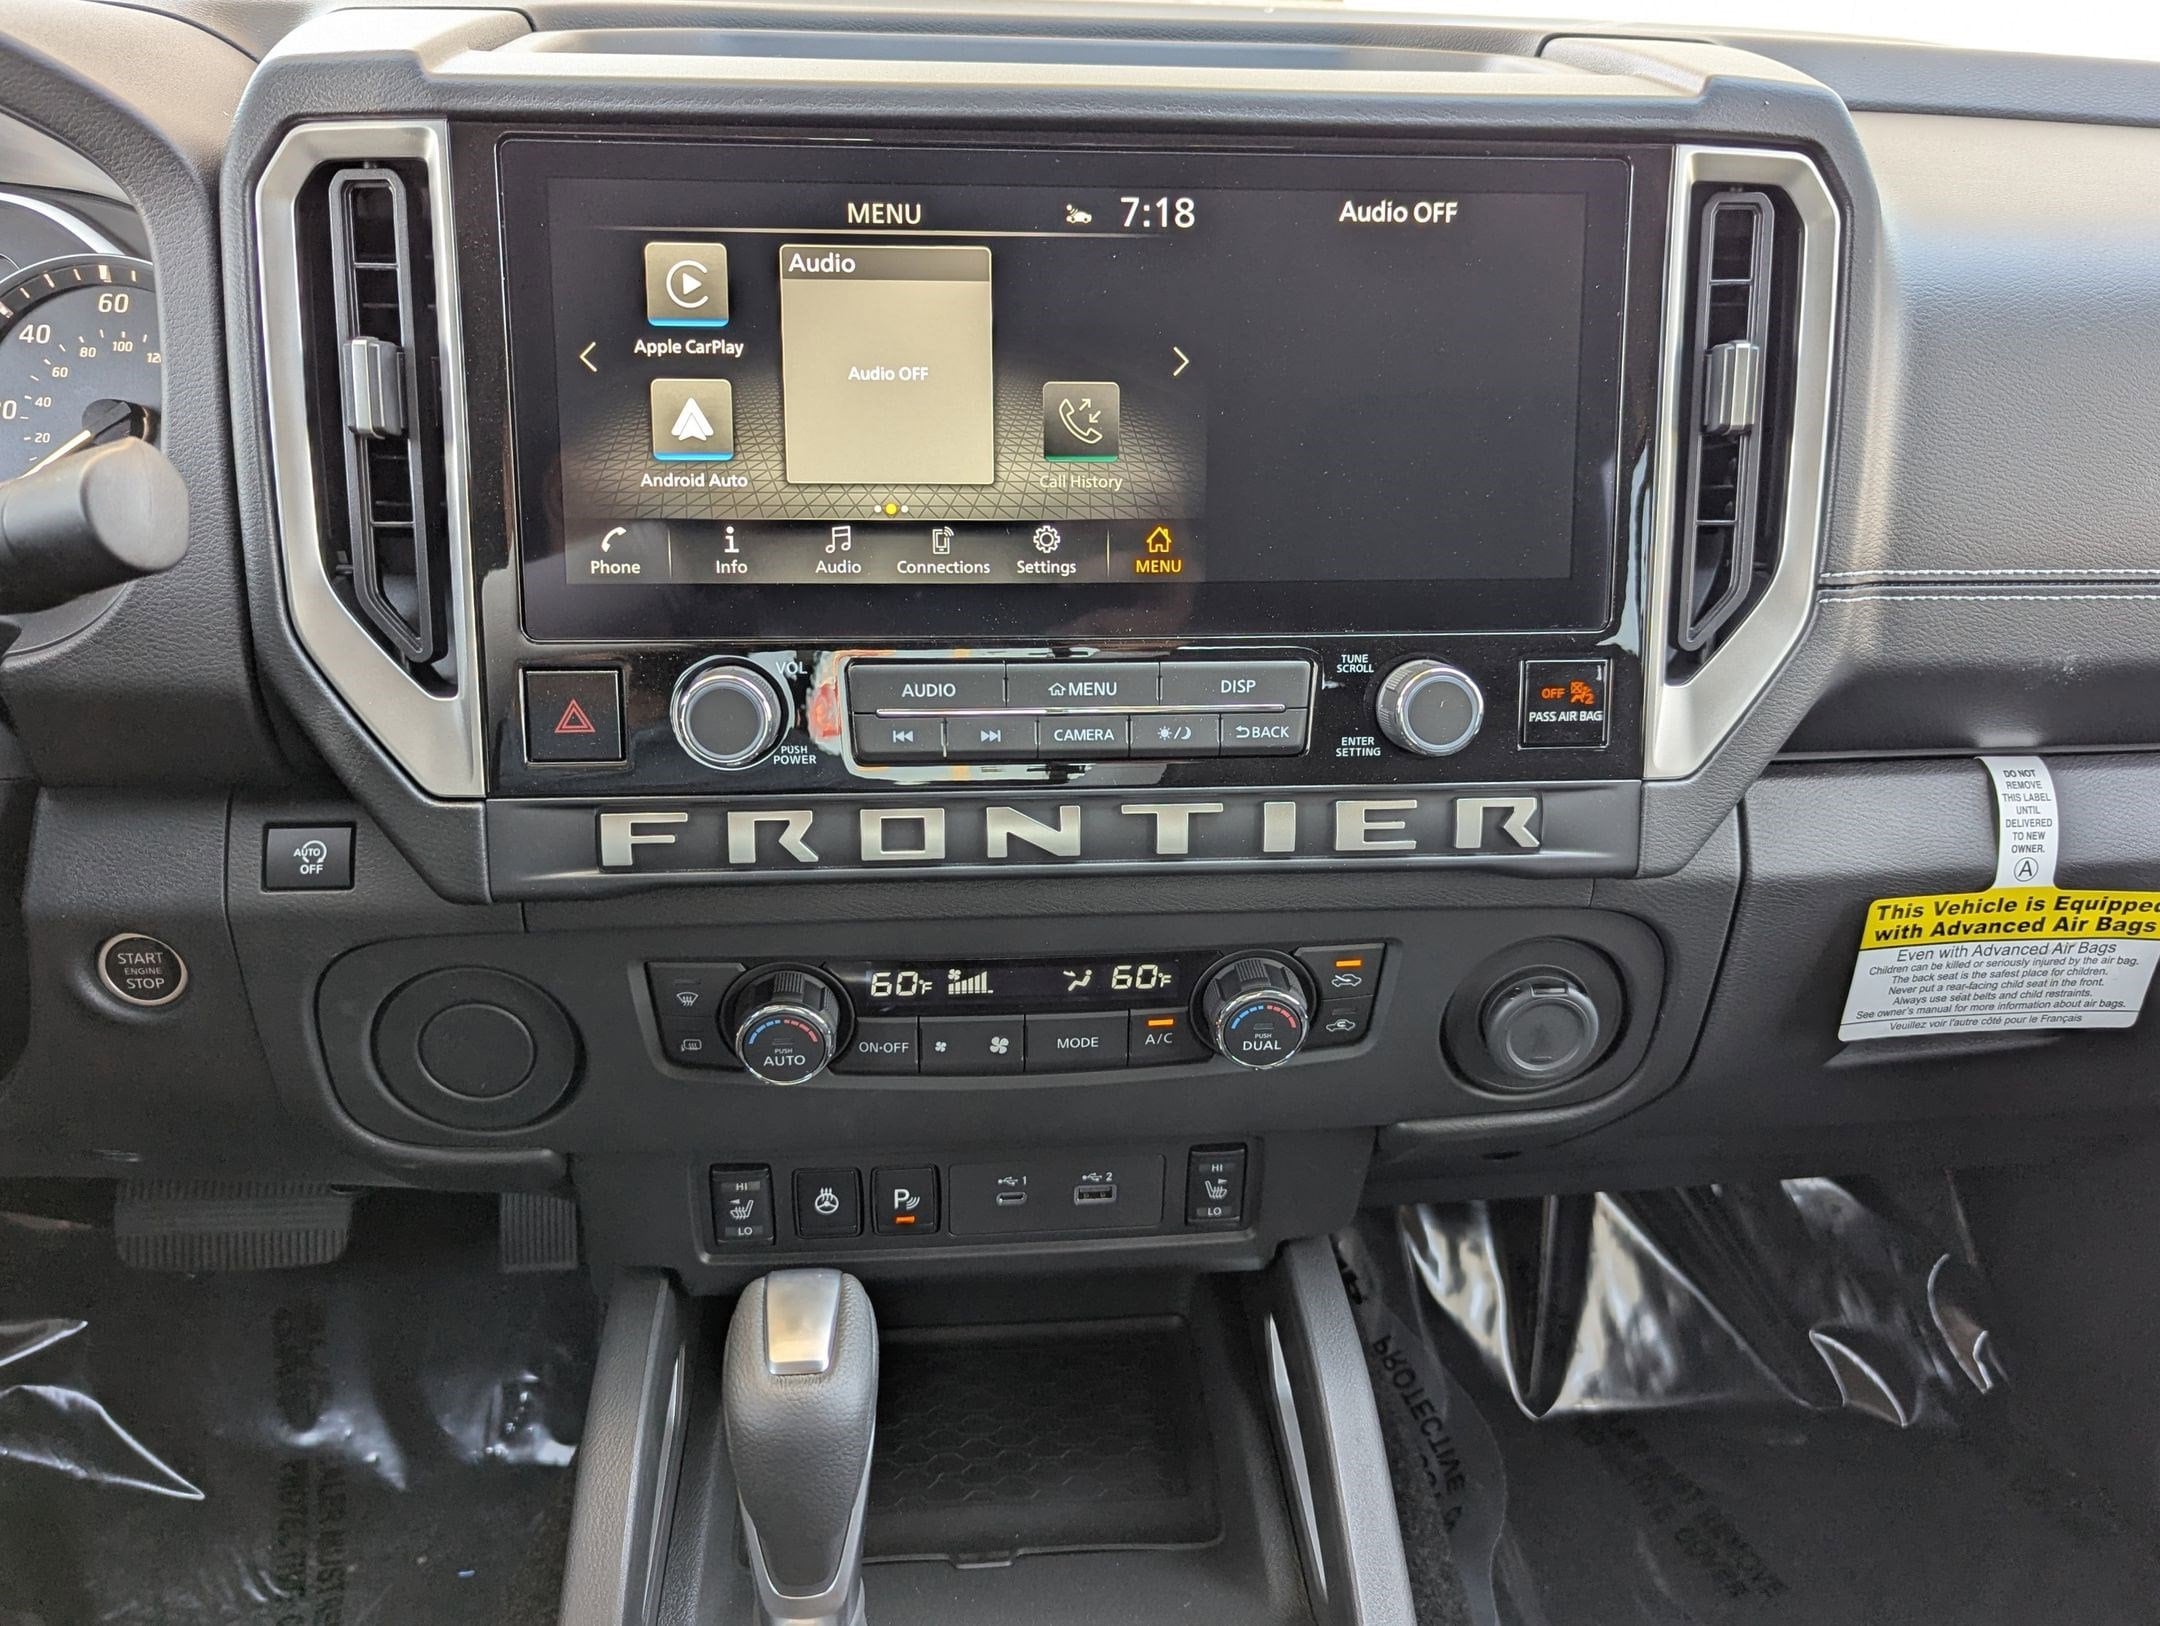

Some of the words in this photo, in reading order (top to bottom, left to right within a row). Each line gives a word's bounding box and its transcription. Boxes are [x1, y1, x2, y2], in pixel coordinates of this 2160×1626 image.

[847, 203, 922, 225] MENU
[1120, 197, 1196, 228] 7:18
[1339, 200, 1408, 223] Audio
[1414, 201, 1458, 224] OFF
[788, 253, 856, 273] Audio
[98, 293, 129, 313] 60
[19, 325, 51, 344] 40
[79, 347, 97, 358] 80
[112, 341, 133, 352] 100
[633, 339, 683, 357] Apple
[685, 339, 745, 358] CarPlay
[146, 353, 161, 363] 12
[51, 367, 69, 378] 60
[848, 366, 895, 381] Audio
[899, 367, 929, 381] OFF
[34, 397, 52, 408] 40
[0, 400, 17, 420] 0
[34, 433, 51, 443] 20
[640, 473, 705, 488] Android
[708, 474, 748, 488] Auto
[1039, 475, 1066, 489] Call
[1070, 475, 1123, 491] History
[590, 560, 641, 575] Phone
[715, 560, 748, 575] Info
[815, 560, 862, 574] Audio
[897, 560, 991, 574] Connections
[1016, 560, 1077, 577] Settings
[1135, 559, 1183, 574] MENU
[1341, 654, 1369, 664] TUNE
[775, 661, 808, 675] VOL
[1336, 664, 1375, 674] SCROLL
[901, 683, 957, 698] AUDIO
[1068, 682, 1118, 697] MENU
[1220, 679, 1257, 694] DISP
[1541, 687, 1565, 699] OFF
[1528, 711, 1556, 723] PASS
[1557, 710, 1578, 722] AIR
[1579, 710, 1604, 722] BAG
[1053, 728, 1115, 742] CAMERA
[1251, 726, 1290, 739] BACK
[1341, 736, 1375, 747] ENTER
[780, 745, 808, 755] PUSH
[1335, 746, 1381, 757] SETTING
[773, 754, 817, 765] POWER
[2003, 770, 2017, 778] DO
[2018, 769, 2036, 778] NOT
[2006, 780, 2043, 790] REMOVE
[2002, 792, 2022, 802] THIS
[2023, 793, 2051, 802] LABEL
[2016, 805, 2041, 815] UNTIL
[2005, 818, 2053, 828] DELIVERED
[600, 797, 1541, 866] FRONTIER
[2013, 832, 2024, 841] TO
[2026, 832, 2046, 841] NEW
[293, 847, 321, 858] AUTO
[2011, 844, 2045, 853] OWNER.
[300, 864, 323, 875] OFF
[2018, 860, 2033, 877] A
[1877, 903, 1924, 920] This
[1933, 897, 2017, 916] Vehicle
[2025, 896, 2045, 912] is
[1875, 924, 1923, 941] with
[1929, 917, 2046, 937] Advanced
[2052, 917, 2089, 932] Air
[2095, 917, 2157, 935] Bags
[117, 952, 163, 964] START
[1897, 950, 1934, 962] Even
[1939, 946, 1968, 958] with
[1971, 943, 2049, 957] Advanced
[2052, 942, 2075, 954] Air
[2078, 942, 2117, 956] Bags
[124, 967, 163, 975] ENGINE
[1869, 964, 1909, 976] Children
[1910, 965, 1928, 973] can
[1930, 961, 1943, 970] be
[1945, 960, 1971, 969] killed
[1973, 960, 1983, 968] or
[1986, 956, 2030, 968] seriously
[2032, 957, 2066, 967] injured
[2068, 957, 2081, 967] by
[2083, 956, 2098, 964] the
[2100, 956, 2116, 964] air
[2116, 956, 2139, 967] bag.
[1892, 975, 1910, 984] The
[1911, 973, 1934, 982] back
[1937, 972, 1958, 980] seat
[1960, 970, 1969, 979] is
[1971, 969, 1987, 978] the
[1989, 968, 2020, 979] safest
[2021, 967, 2049, 978] place
[2051, 967, 2066, 976] for
[2066, 966, 2109, 976] children.
[126, 978, 165, 989] STOP
[1888, 986, 1918, 995] Never
[1919, 984, 1935, 994] put
[1946, 980, 1998, 992] rear-facing
[2000, 979, 2024, 989] child
[2026, 979, 2049, 988] seat
[2061, 978, 2078, 986] the
[2080, 978, 2105, 986] front.
[1892, 996, 1928, 1006] Always
[1929, 995, 1948, 1003] use
[1950, 992, 1971, 1001] seat
[1973, 991, 1997, 1000] belts
[1998, 990, 2018, 1000] and
[2019, 989, 2043, 999] child
[2045, 988, 2093, 998] restraints.
[1856, 1011, 1876, 1019] See
[1877, 1006, 1914, 1018] owner's
[1916, 1004, 1952, 1014] manual
[1954, 1003, 1969, 1012] for
[1970, 1002, 1996, 1011] more
[1997, 1000, 2052, 1011] information
[2053, 999, 2082, 1009] about
[2083, 999, 2098, 1007] air
[2100, 999, 2127, 1009] bags.
[1889, 1019, 1928, 1030] Veuillez
[1929, 1018, 1948, 1027] voir
[1949, 1017, 1979, 1027] l'autre
[1980, 1015, 2002, 1025] côté
[2004, 1015, 2028, 1026] pour
[2029, 1014, 2039, 1023] le
[2040, 1013, 2083, 1024] Français
[1057, 1037, 1099, 1049] MODE
[1145, 1032, 1174, 1045] A/C
[1242, 1039, 1282, 1051] DUAL
[763, 1055, 806, 1067] AUTO
[1211, 1164, 1224, 1173] HI
[1022, 1176, 1027, 1186] 1
[1105, 1172, 1113, 1182] 2
[735, 1182, 748, 1192] HI
[893, 1189, 909, 1210] P
[1207, 1207, 1222, 1216] LO
[738, 1227, 753, 1236] LO
